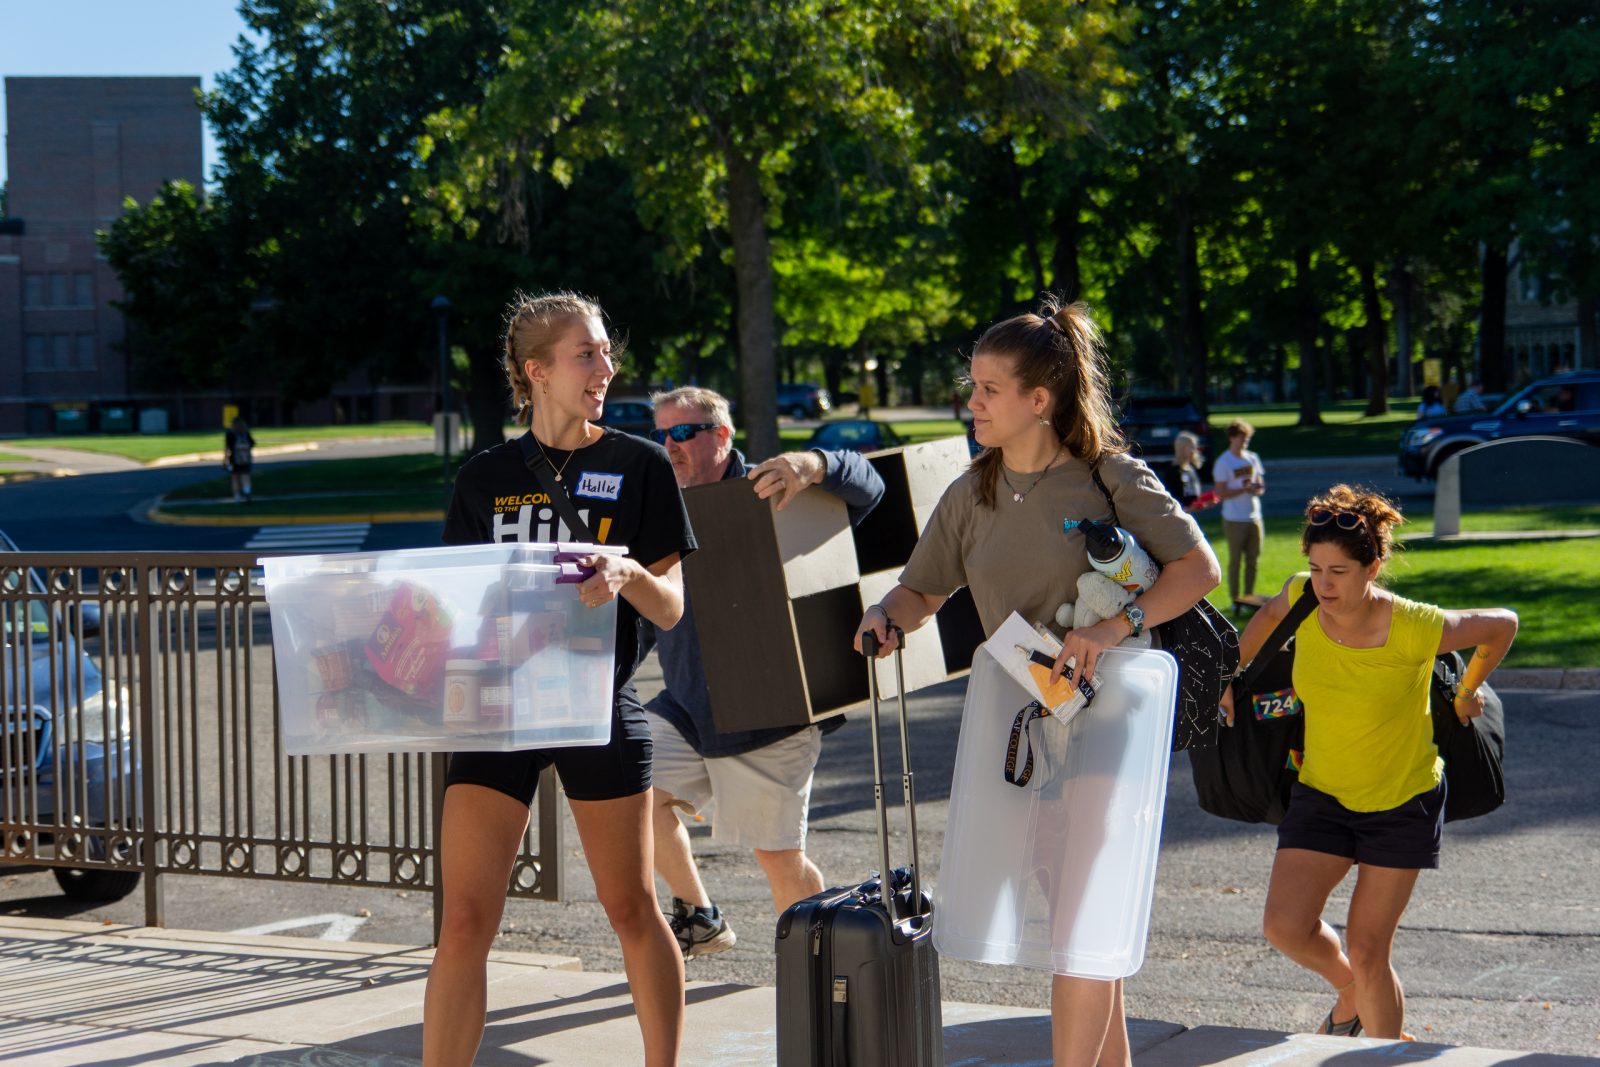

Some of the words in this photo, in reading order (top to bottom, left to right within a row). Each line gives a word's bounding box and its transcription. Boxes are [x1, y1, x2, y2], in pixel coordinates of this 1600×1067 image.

[582, 479, 616, 494] Hallie
[494, 493, 552, 506] WELCO
[1260, 695, 1295, 715] 724
[1006, 733, 1019, 775] COLLEGE
